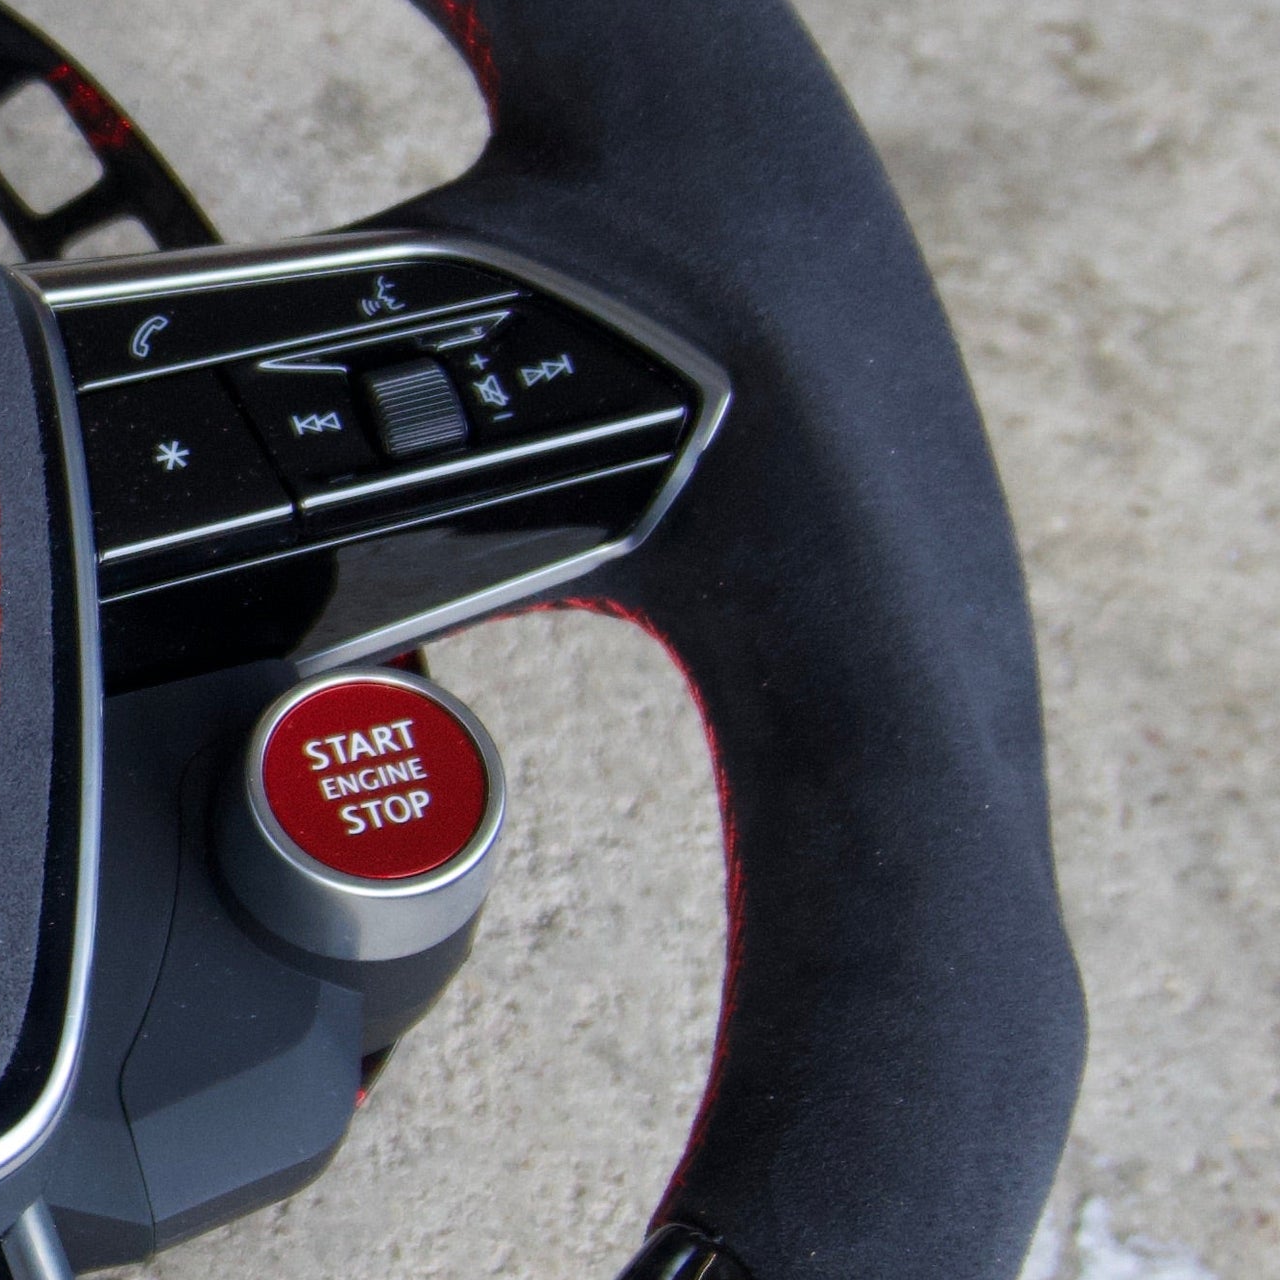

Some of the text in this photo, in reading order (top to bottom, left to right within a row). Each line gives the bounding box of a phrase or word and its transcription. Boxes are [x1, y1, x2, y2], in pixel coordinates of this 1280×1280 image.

[305, 720, 414, 770] START
[321, 758, 427, 800] ENGINE
[341, 790, 430, 835] STOP
